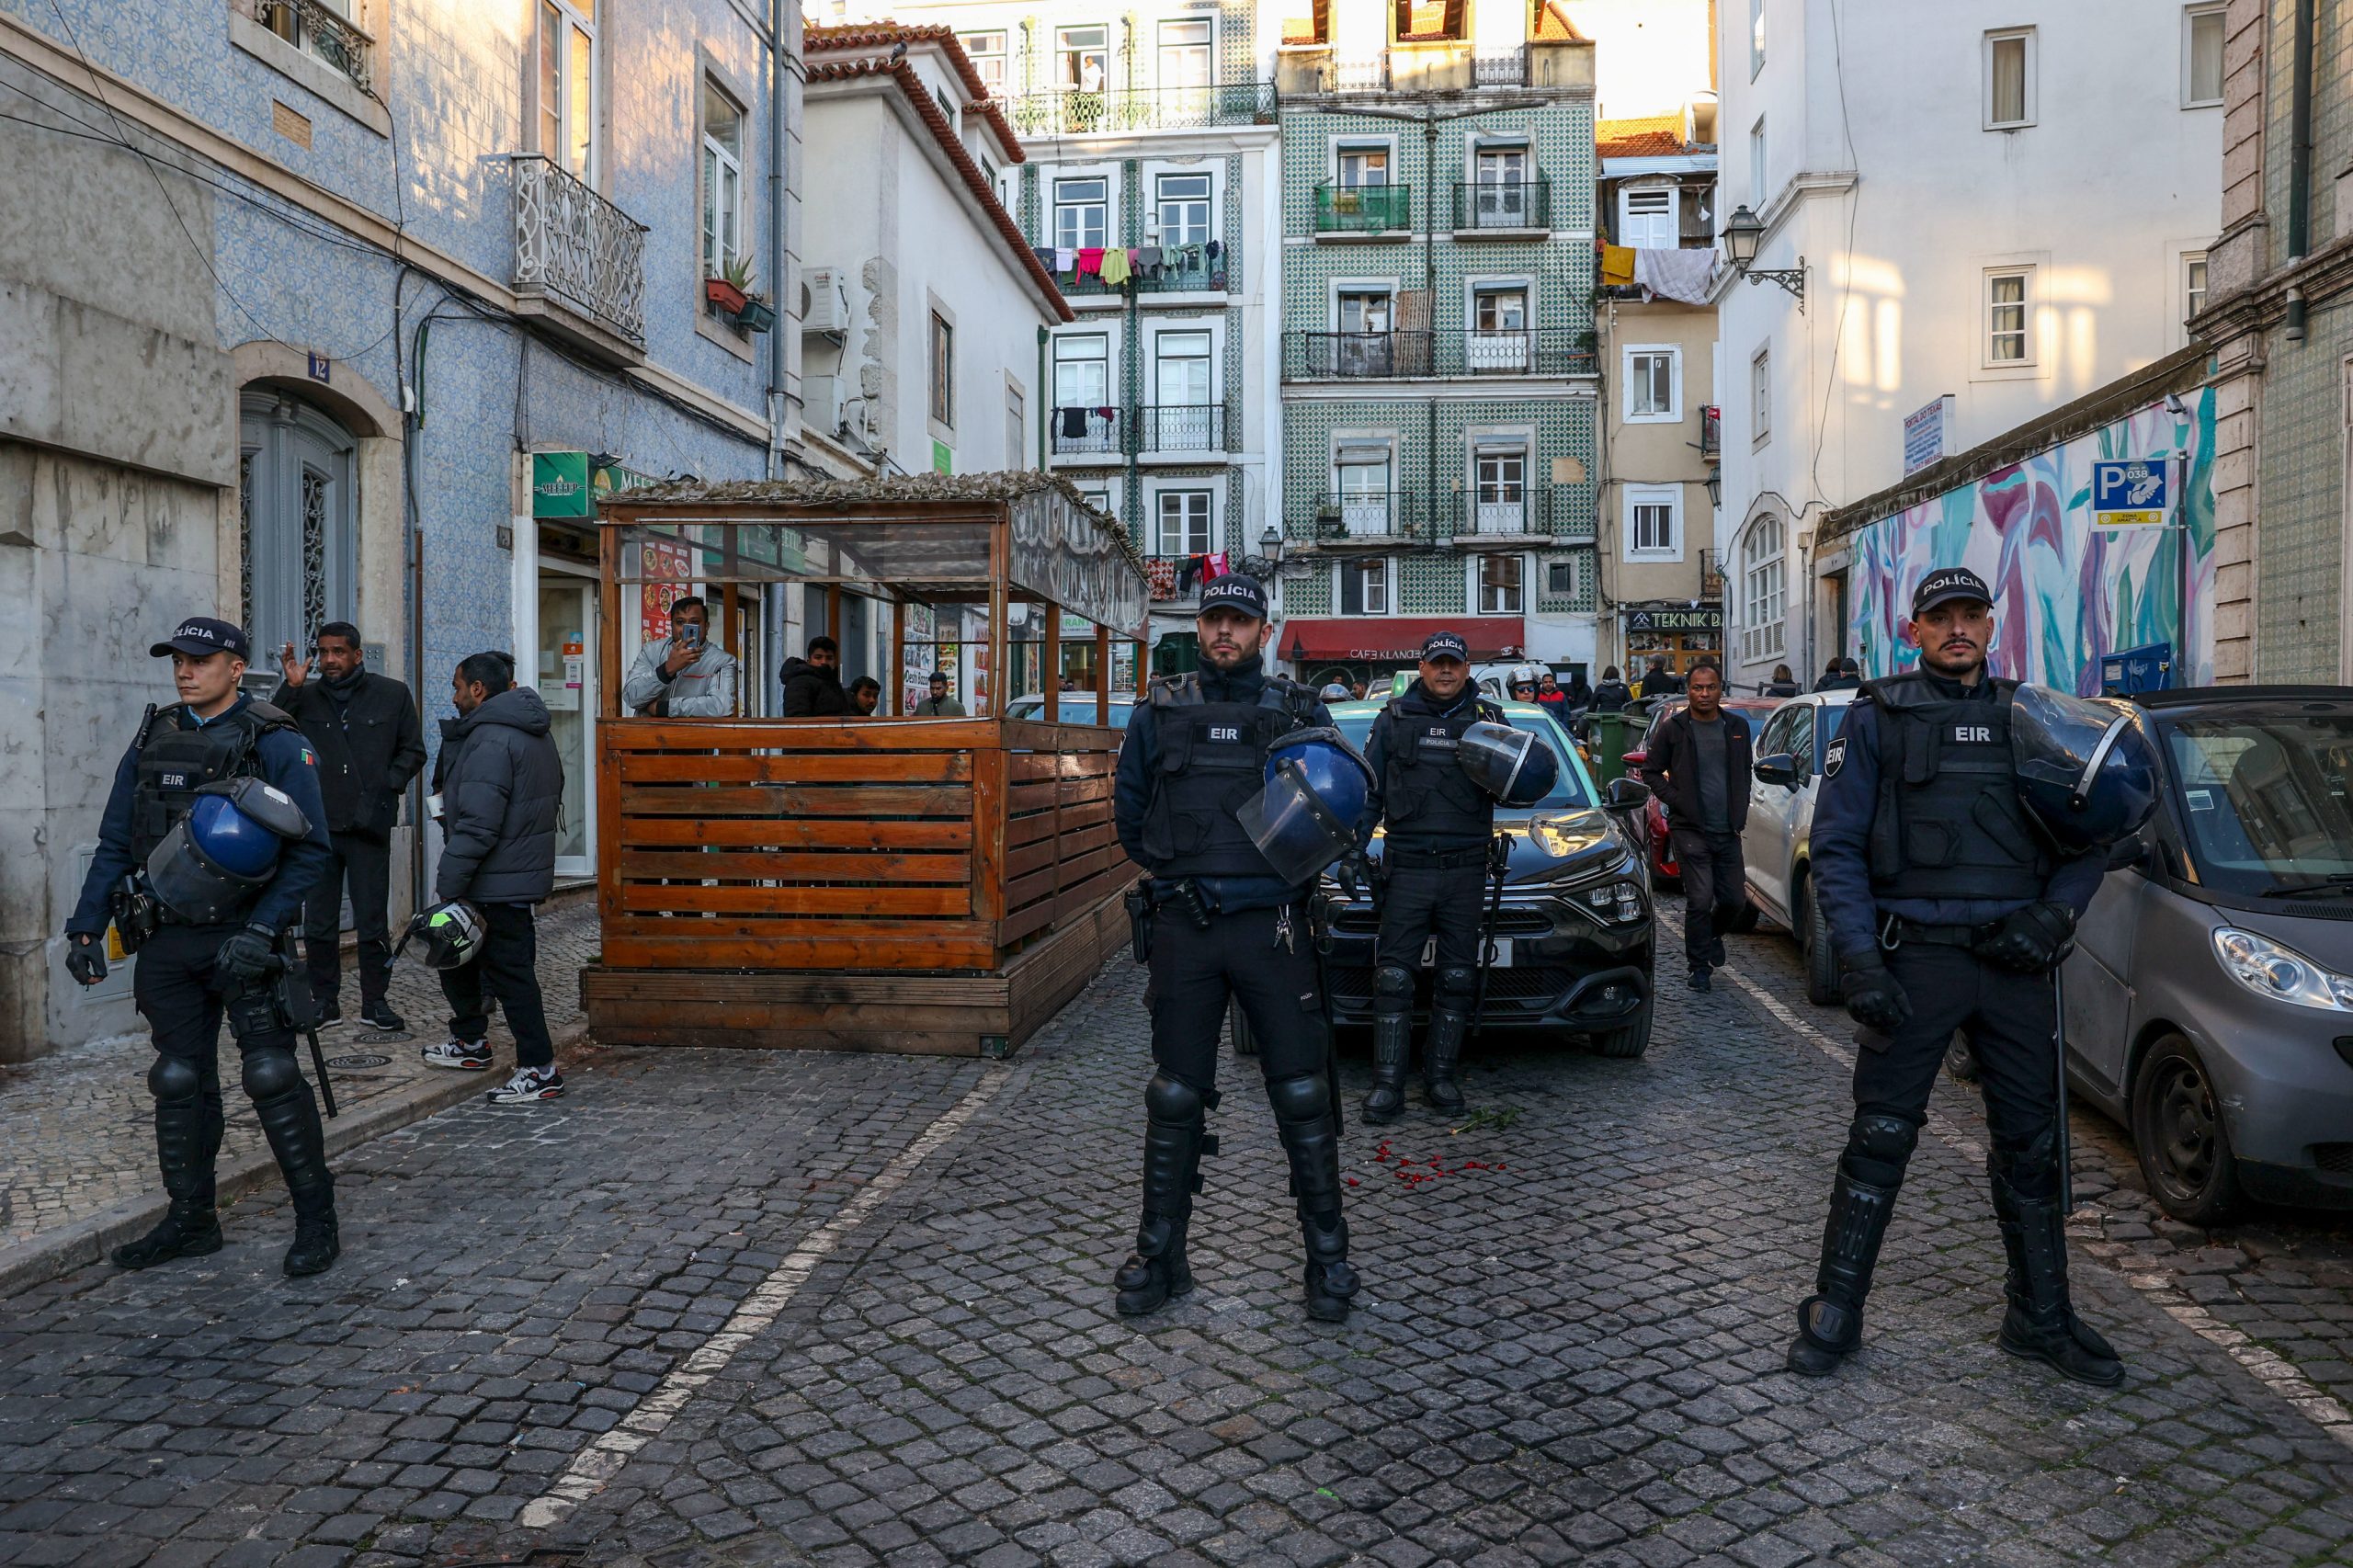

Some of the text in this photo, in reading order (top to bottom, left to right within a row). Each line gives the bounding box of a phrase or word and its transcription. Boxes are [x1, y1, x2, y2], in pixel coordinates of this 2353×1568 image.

[315, 355, 326, 379] 12
[2101, 466, 2148, 500] P 038
[1203, 583, 1257, 602] POLÍCIA
[1923, 574, 1985, 597] POLÍCIA
[1651, 612, 1707, 628] TEKNIK
[173, 625, 214, 640] OLÍCIA
[1427, 638, 1464, 653] POLÍCIA
[1349, 649, 1378, 660] CAFE
[1211, 727, 1238, 740] EIR
[1429, 727, 1446, 736] EIR
[1955, 726, 1991, 742] EIR
[1827, 746, 1843, 765] EIR
[162, 774, 185, 786] EIR
